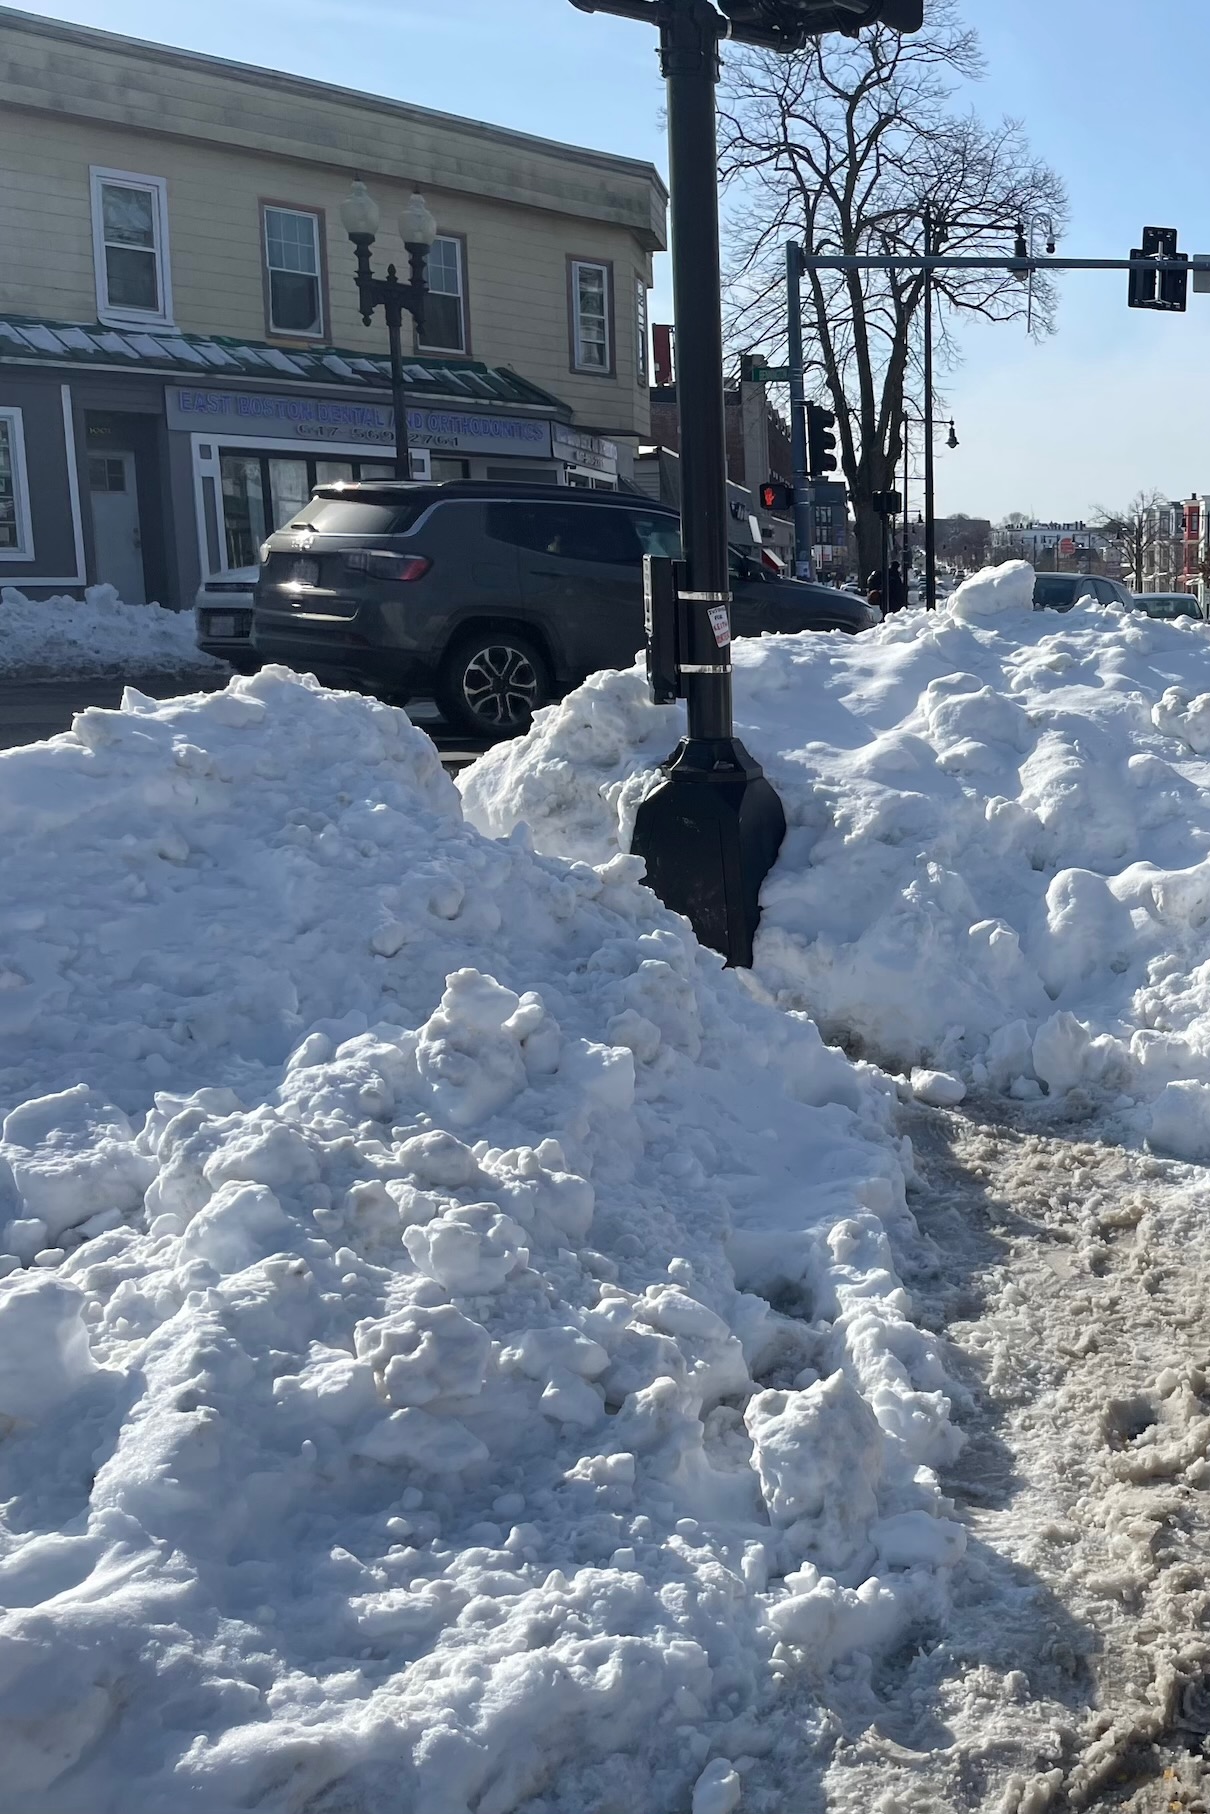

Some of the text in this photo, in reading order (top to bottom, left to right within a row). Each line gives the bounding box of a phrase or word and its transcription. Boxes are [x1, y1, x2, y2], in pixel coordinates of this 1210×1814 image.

[179, 390, 545, 441] EAST BOSTON DENTAL ND ORTHODONTICS
